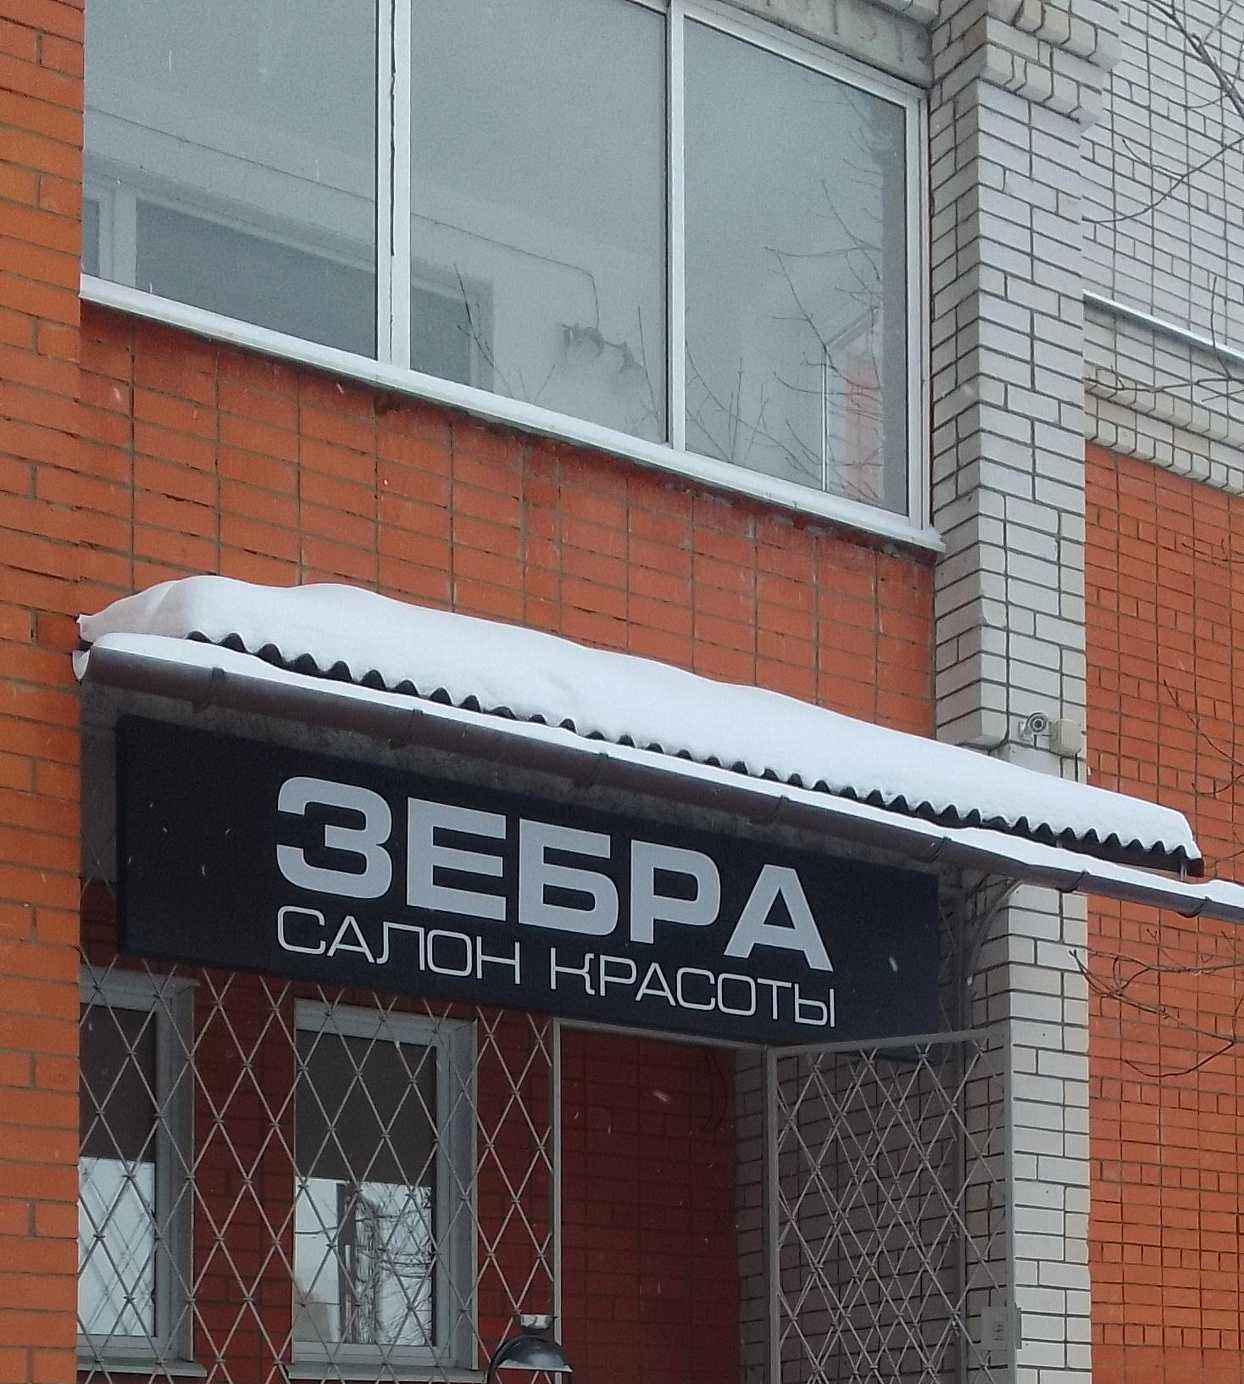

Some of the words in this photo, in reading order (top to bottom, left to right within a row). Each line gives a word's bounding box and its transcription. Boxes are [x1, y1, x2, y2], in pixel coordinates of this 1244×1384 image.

[276, 776, 834, 973] ЗЕБРА
[277, 905, 521, 985] САЛОН
[550, 947, 836, 1028] КРАСОТЫ
